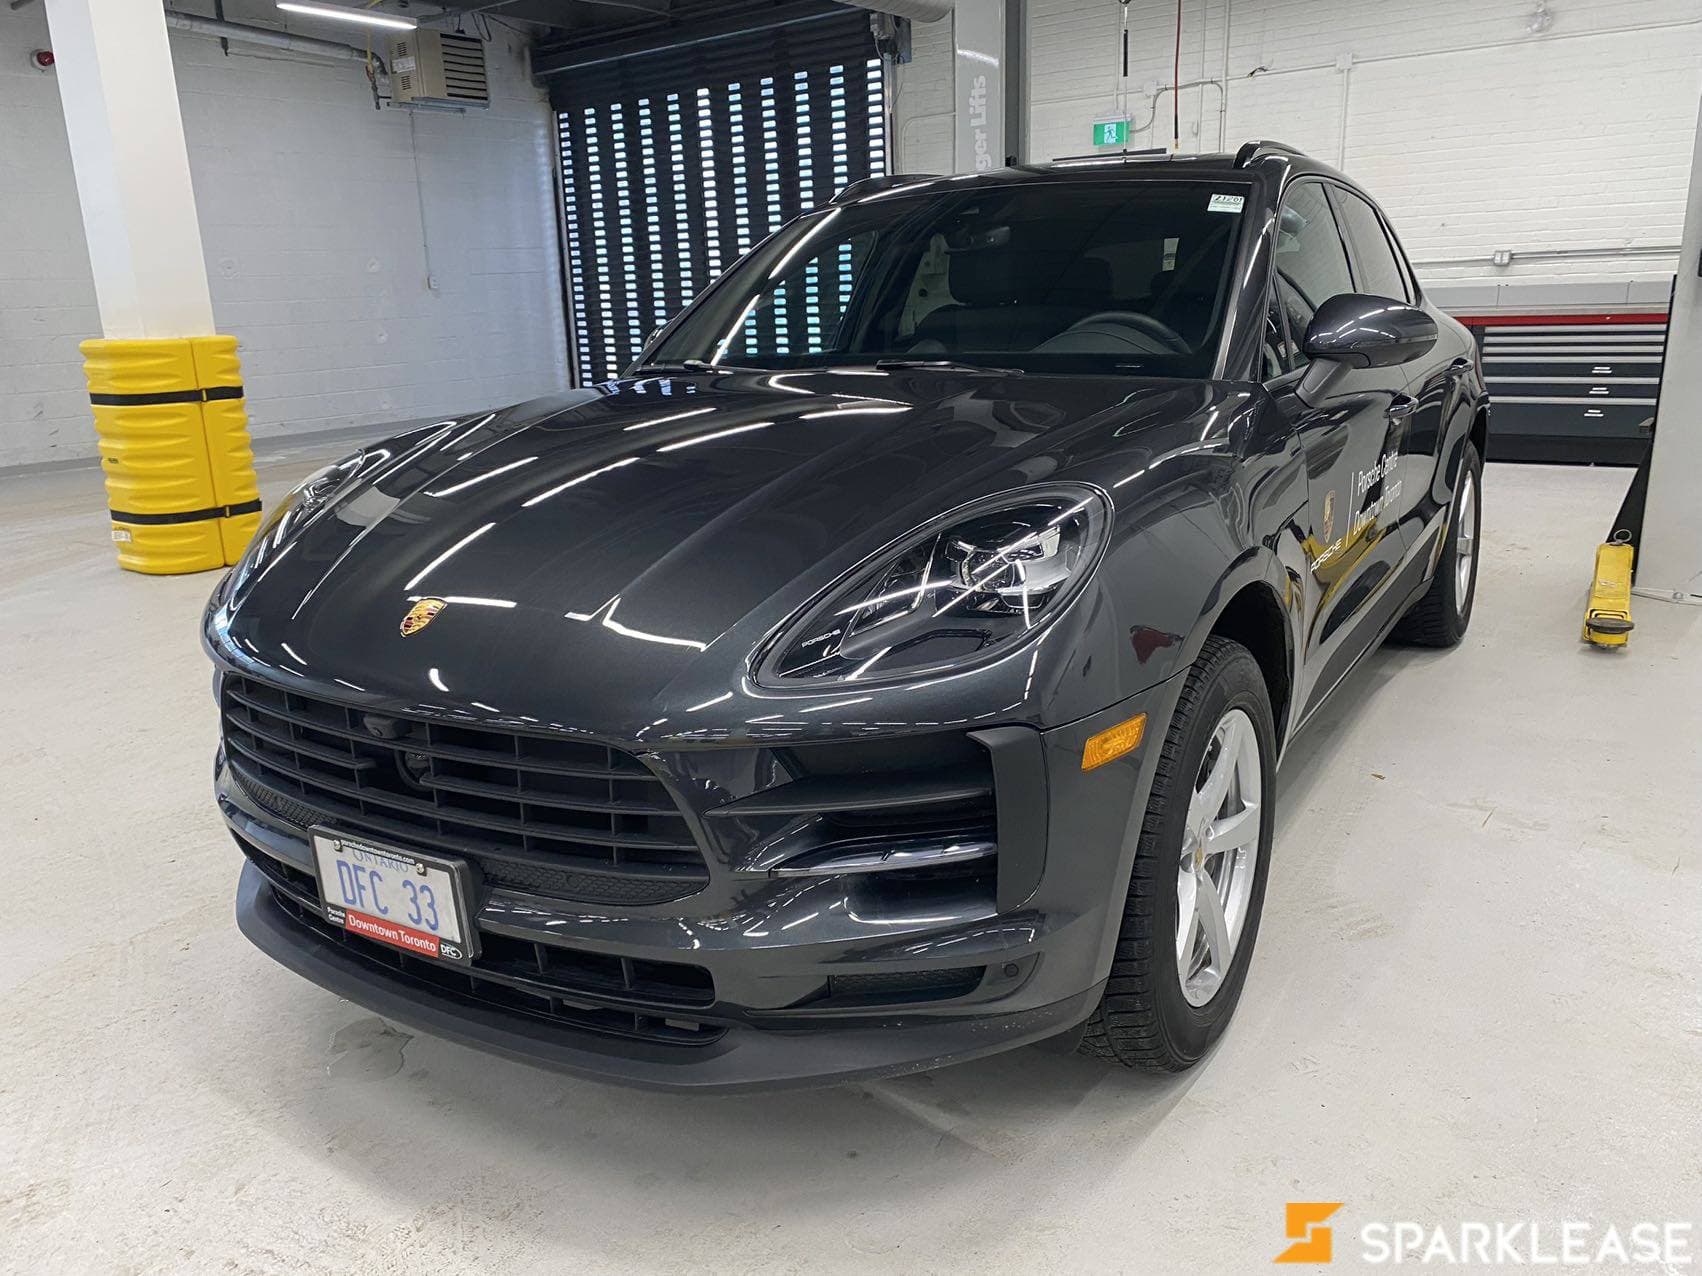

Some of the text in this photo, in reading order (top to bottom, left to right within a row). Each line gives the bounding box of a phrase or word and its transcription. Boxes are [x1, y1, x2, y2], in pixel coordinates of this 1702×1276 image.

[969, 75, 995, 173] ger Lifts
[1357, 450, 1399, 496] Porsche Centre
[802, 629, 841, 648] PORSCHE
[336, 860, 440, 931] DFC 33
[349, 914, 436, 952] Downtown Toronto
[440, 945, 458, 957] DFC
